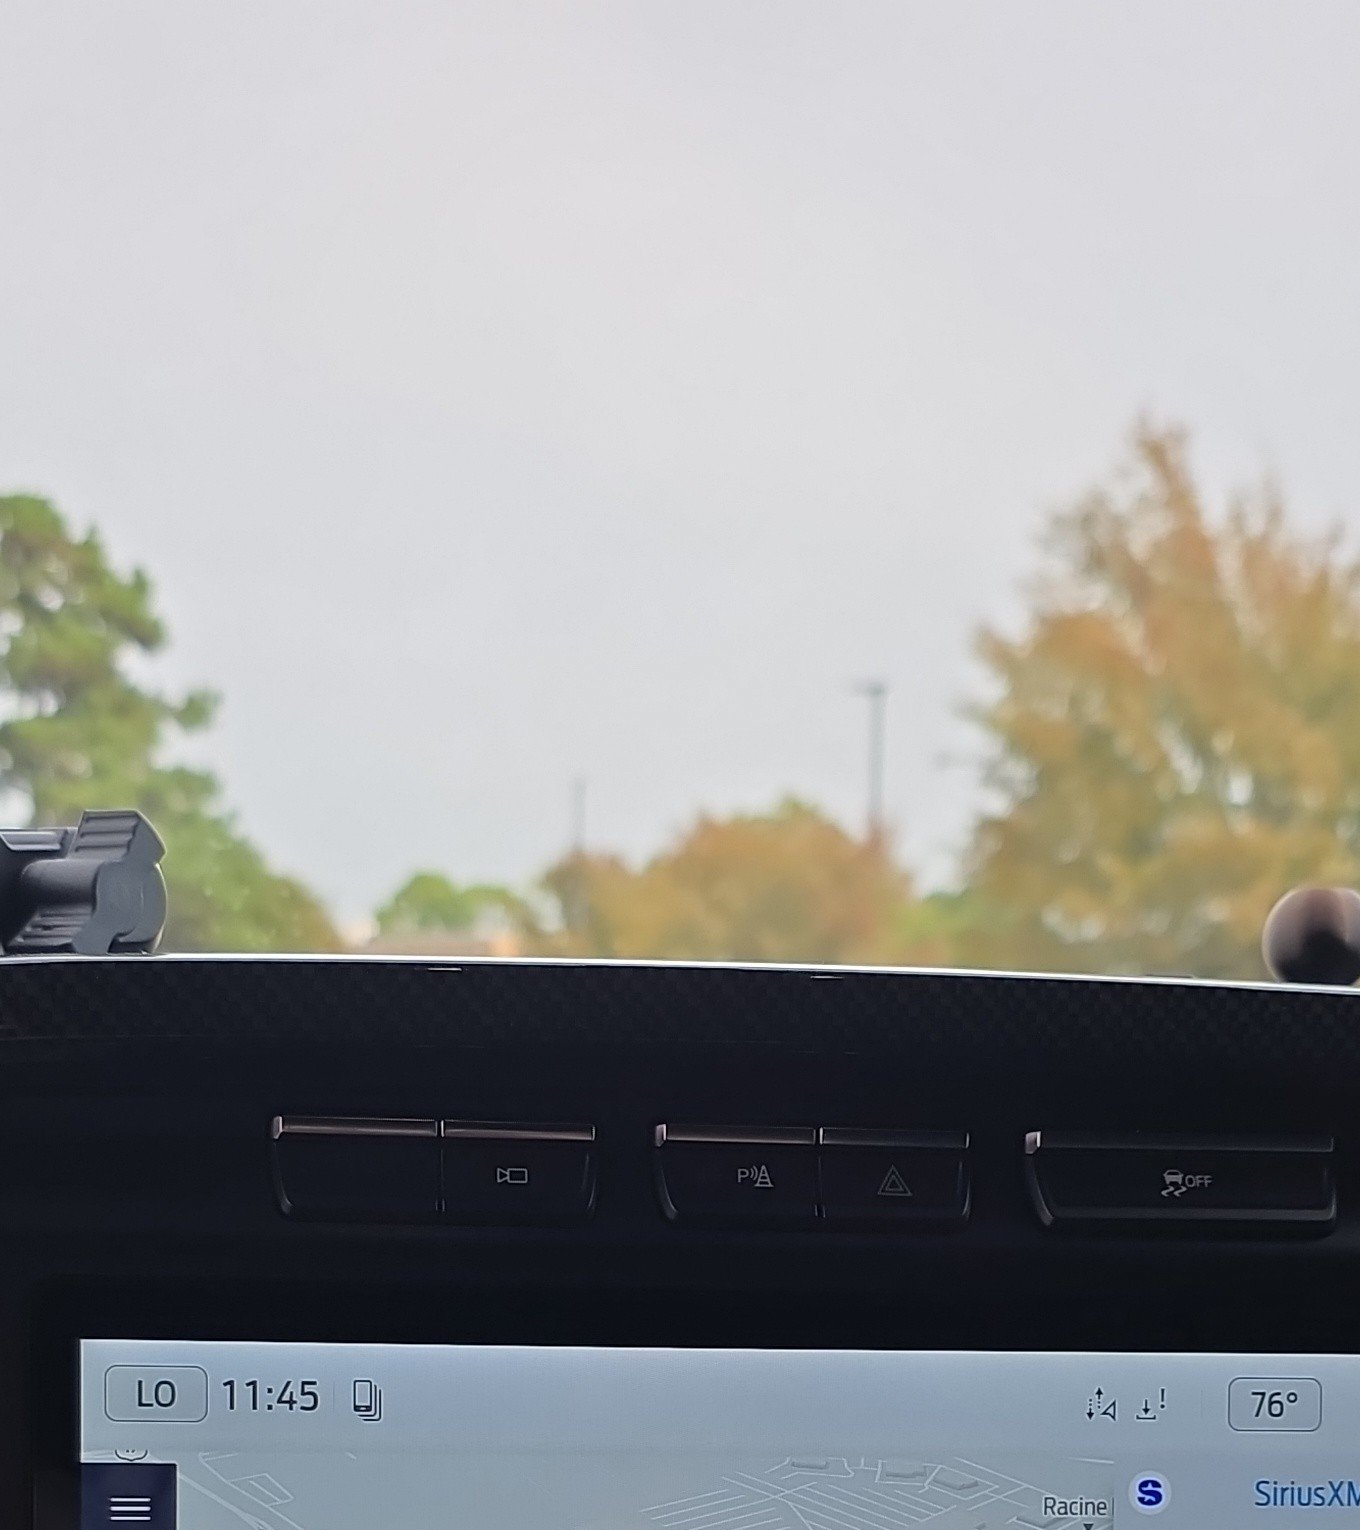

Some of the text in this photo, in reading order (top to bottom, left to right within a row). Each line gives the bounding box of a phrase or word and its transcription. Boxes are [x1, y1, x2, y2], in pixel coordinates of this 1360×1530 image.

[1185, 1174, 1213, 1188] OFF
[136, 1380, 176, 1408] LO
[222, 1380, 320, 1411] 11:45
[1251, 1391, 1298, 1418] 76°
[1043, 1497, 1107, 1516] Racine
